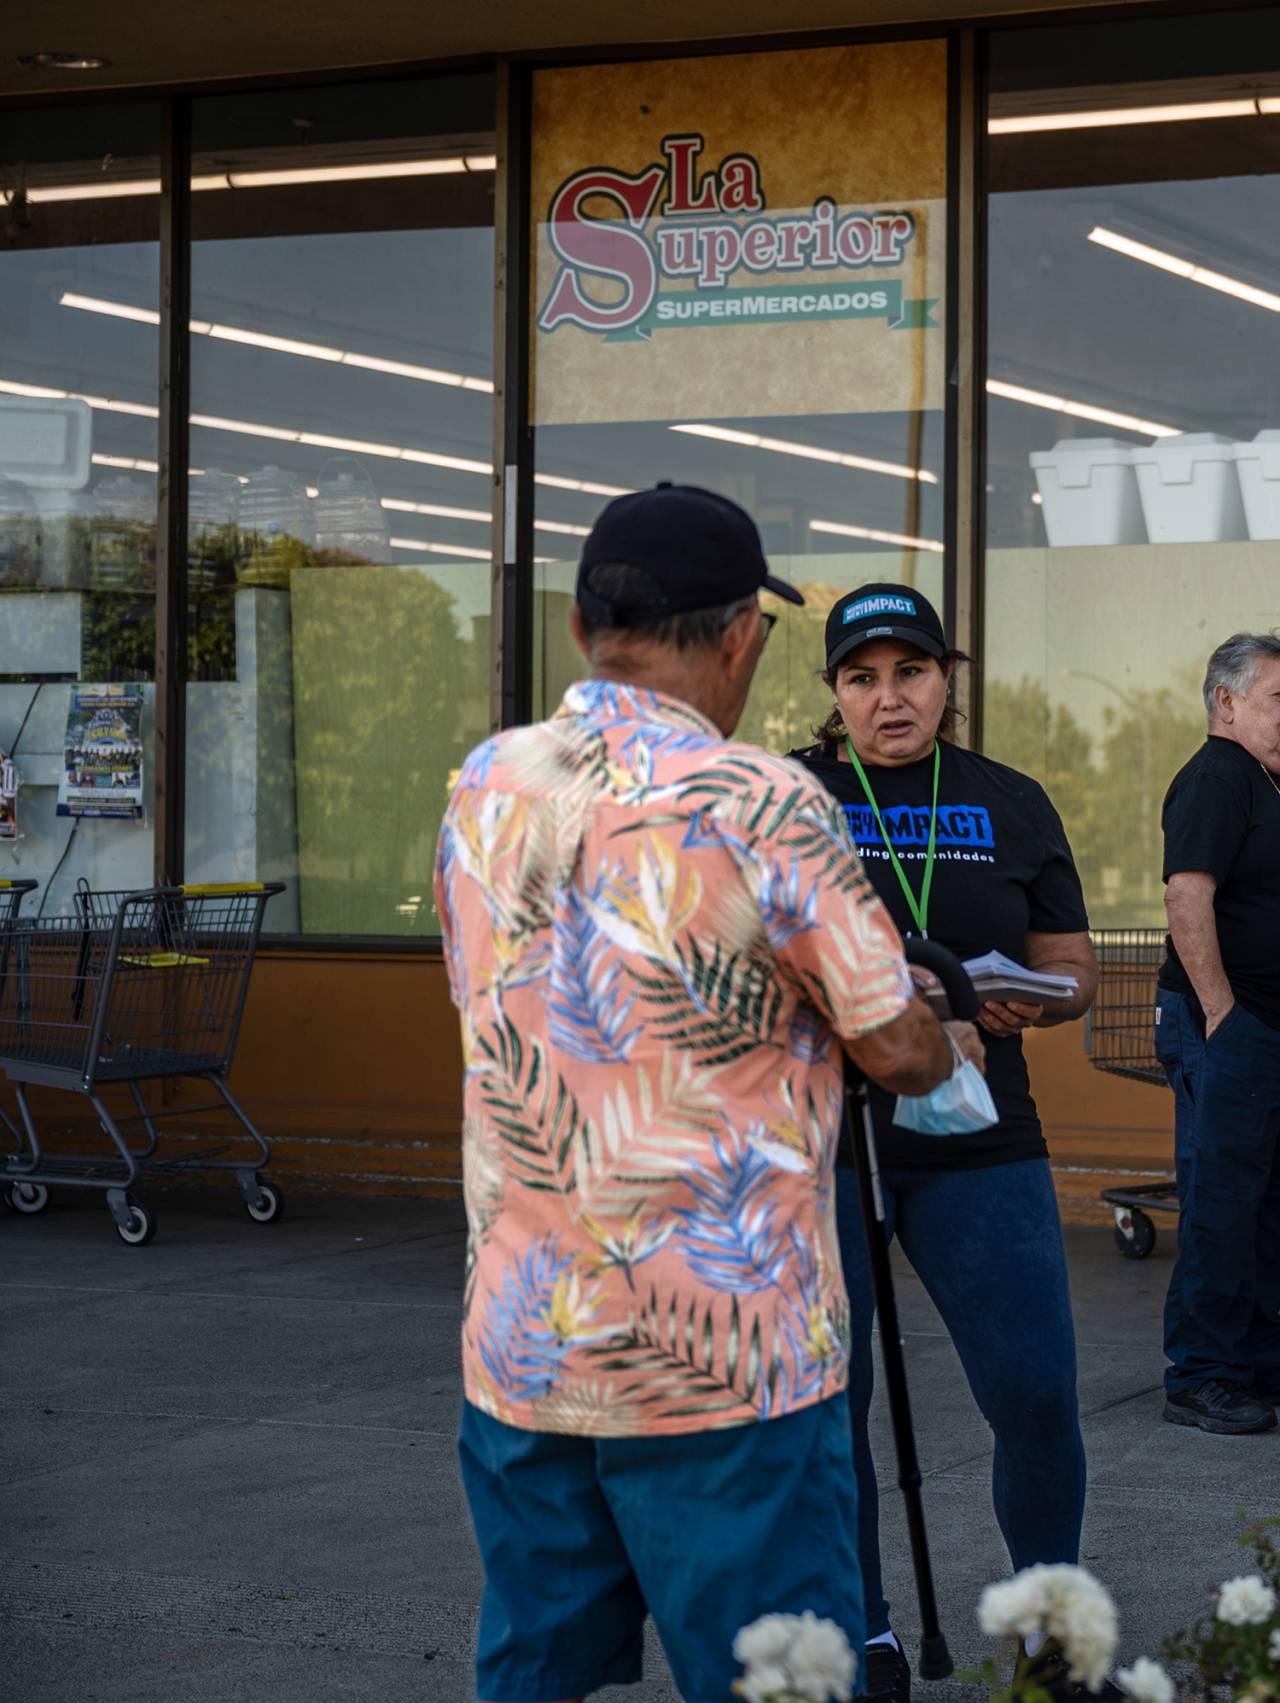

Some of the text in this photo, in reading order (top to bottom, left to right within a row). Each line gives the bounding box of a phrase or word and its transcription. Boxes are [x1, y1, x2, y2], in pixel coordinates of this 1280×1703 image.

[663, 136, 763, 214] La
[538, 166, 913, 332] Superior
[863, 598, 913, 614] IMPACT
[856, 848, 995, 863] ding comnidades
